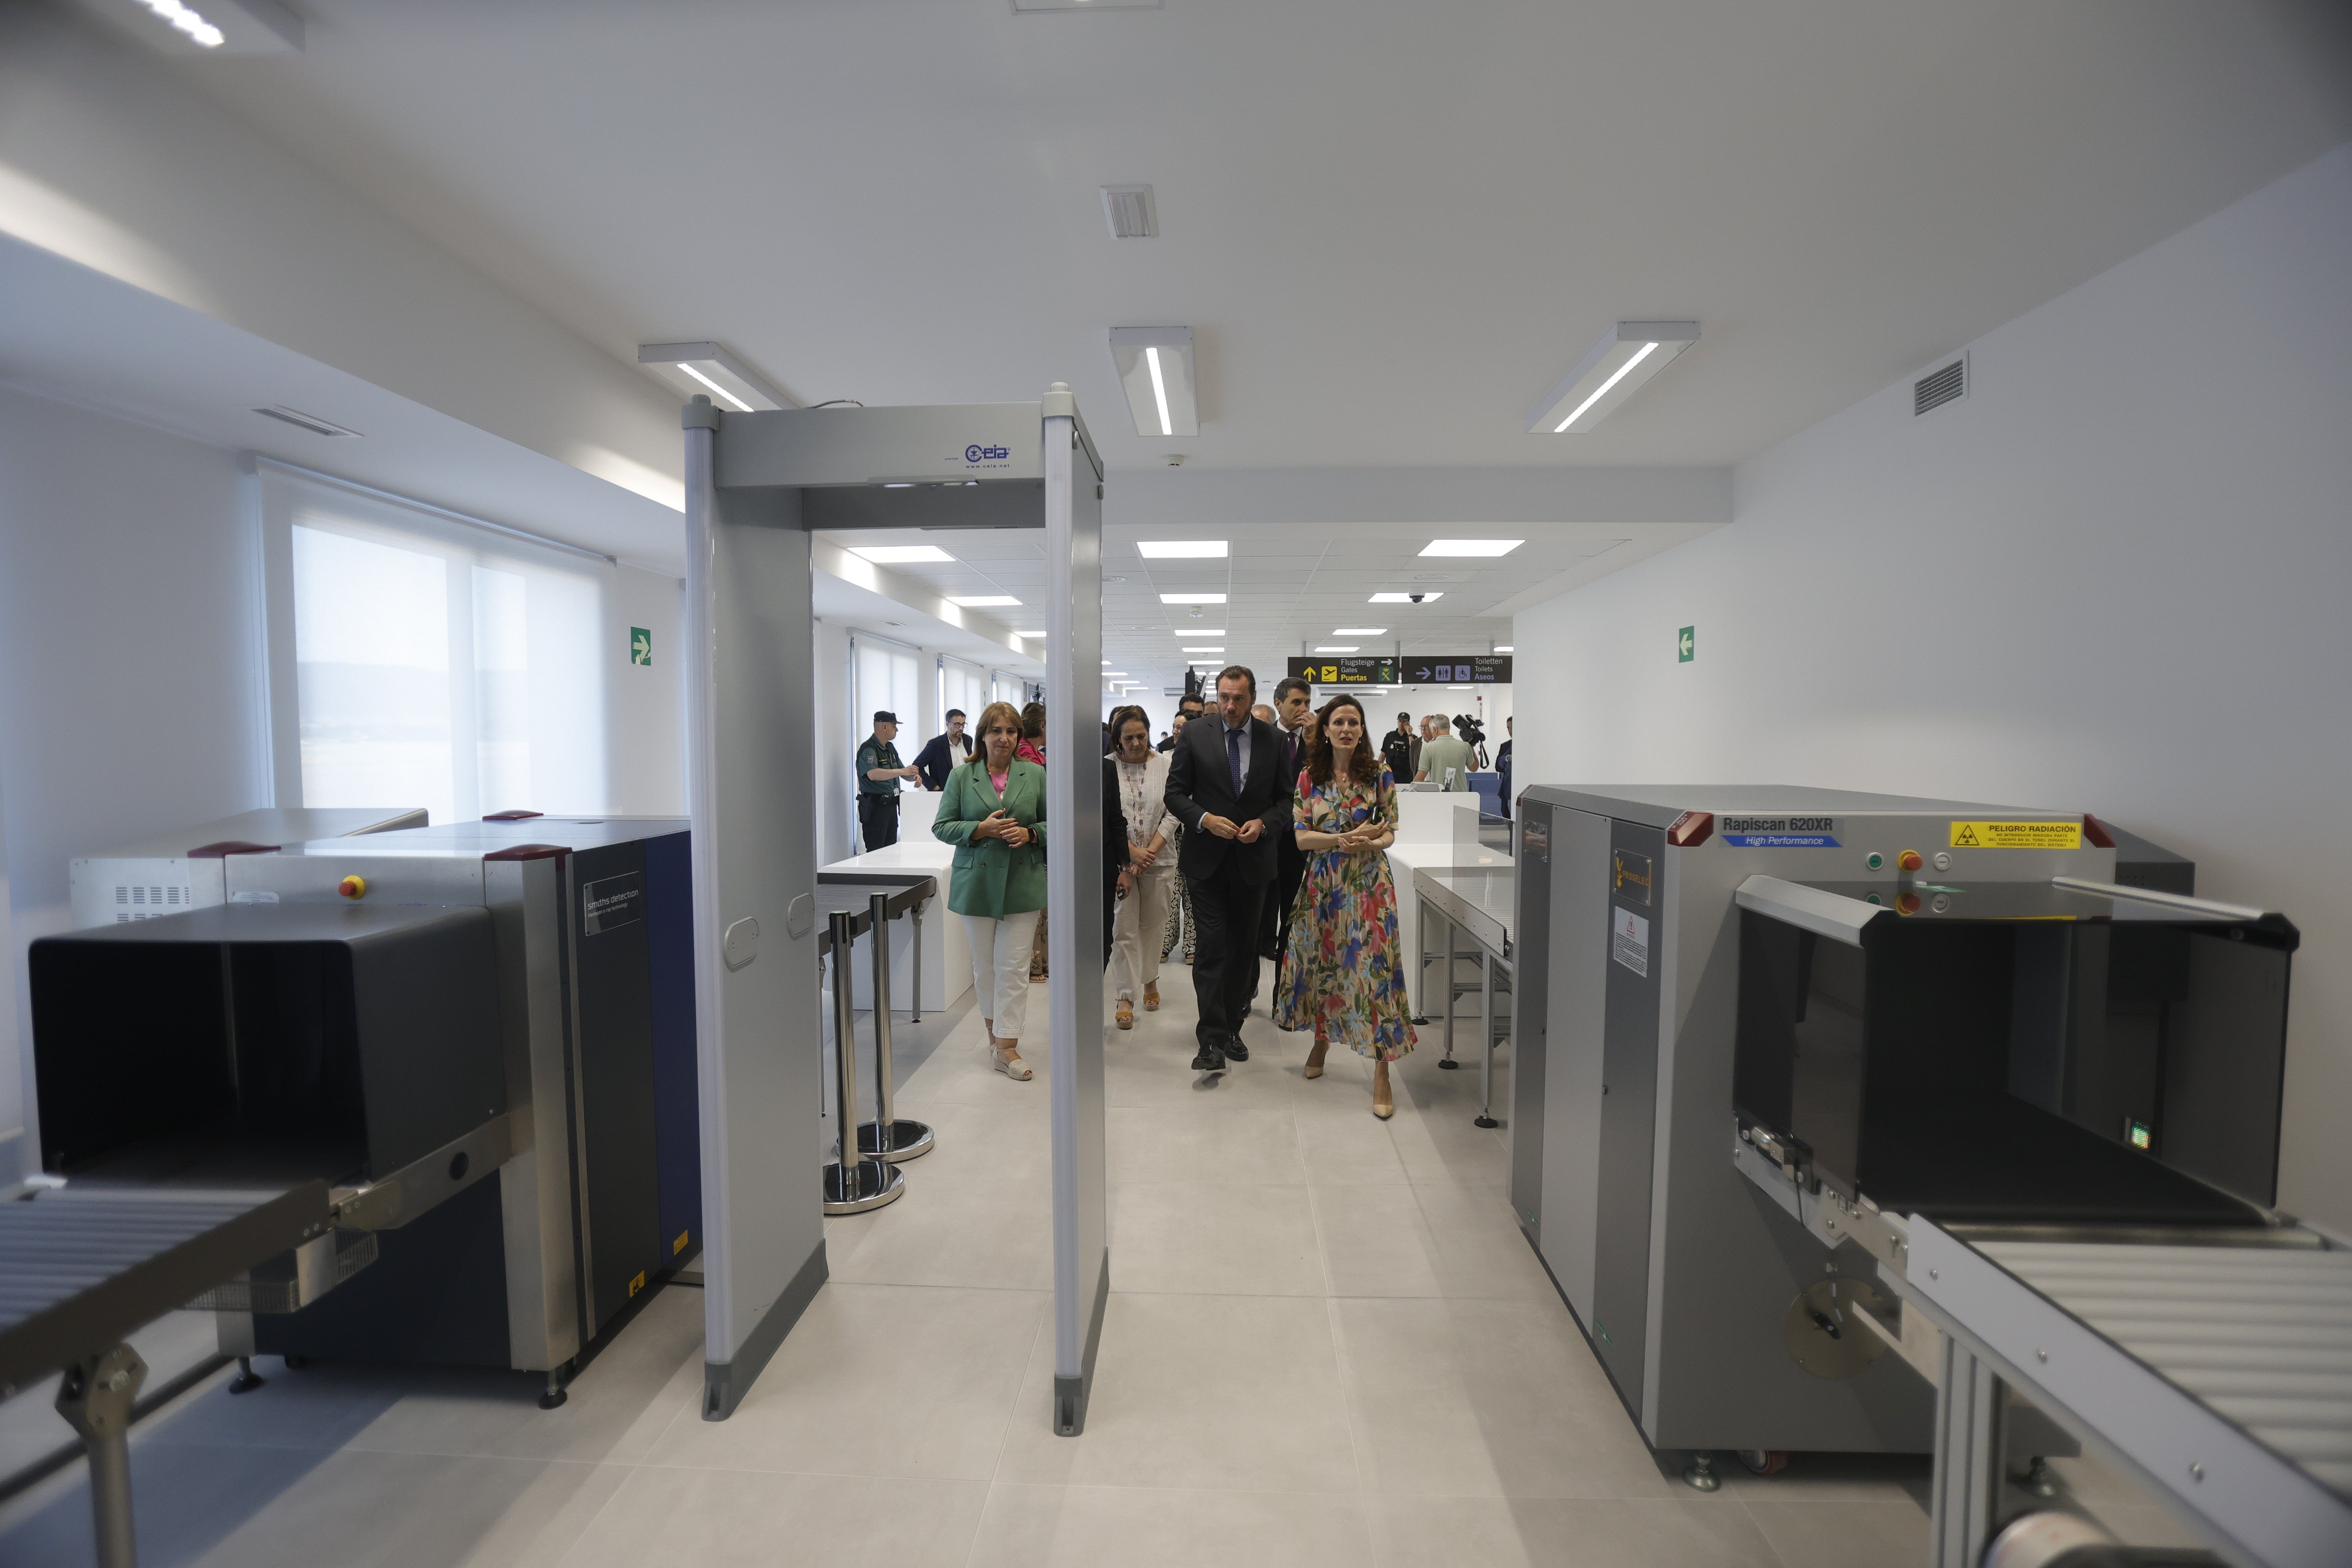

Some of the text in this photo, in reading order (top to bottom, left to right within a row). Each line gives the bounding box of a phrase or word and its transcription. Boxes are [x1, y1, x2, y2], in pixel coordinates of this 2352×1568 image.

[1724, 817, 1833, 833] Rapiscan 620XR
[1746, 837, 1824, 846] High Performance
[588, 890, 639, 910] smiths detection
